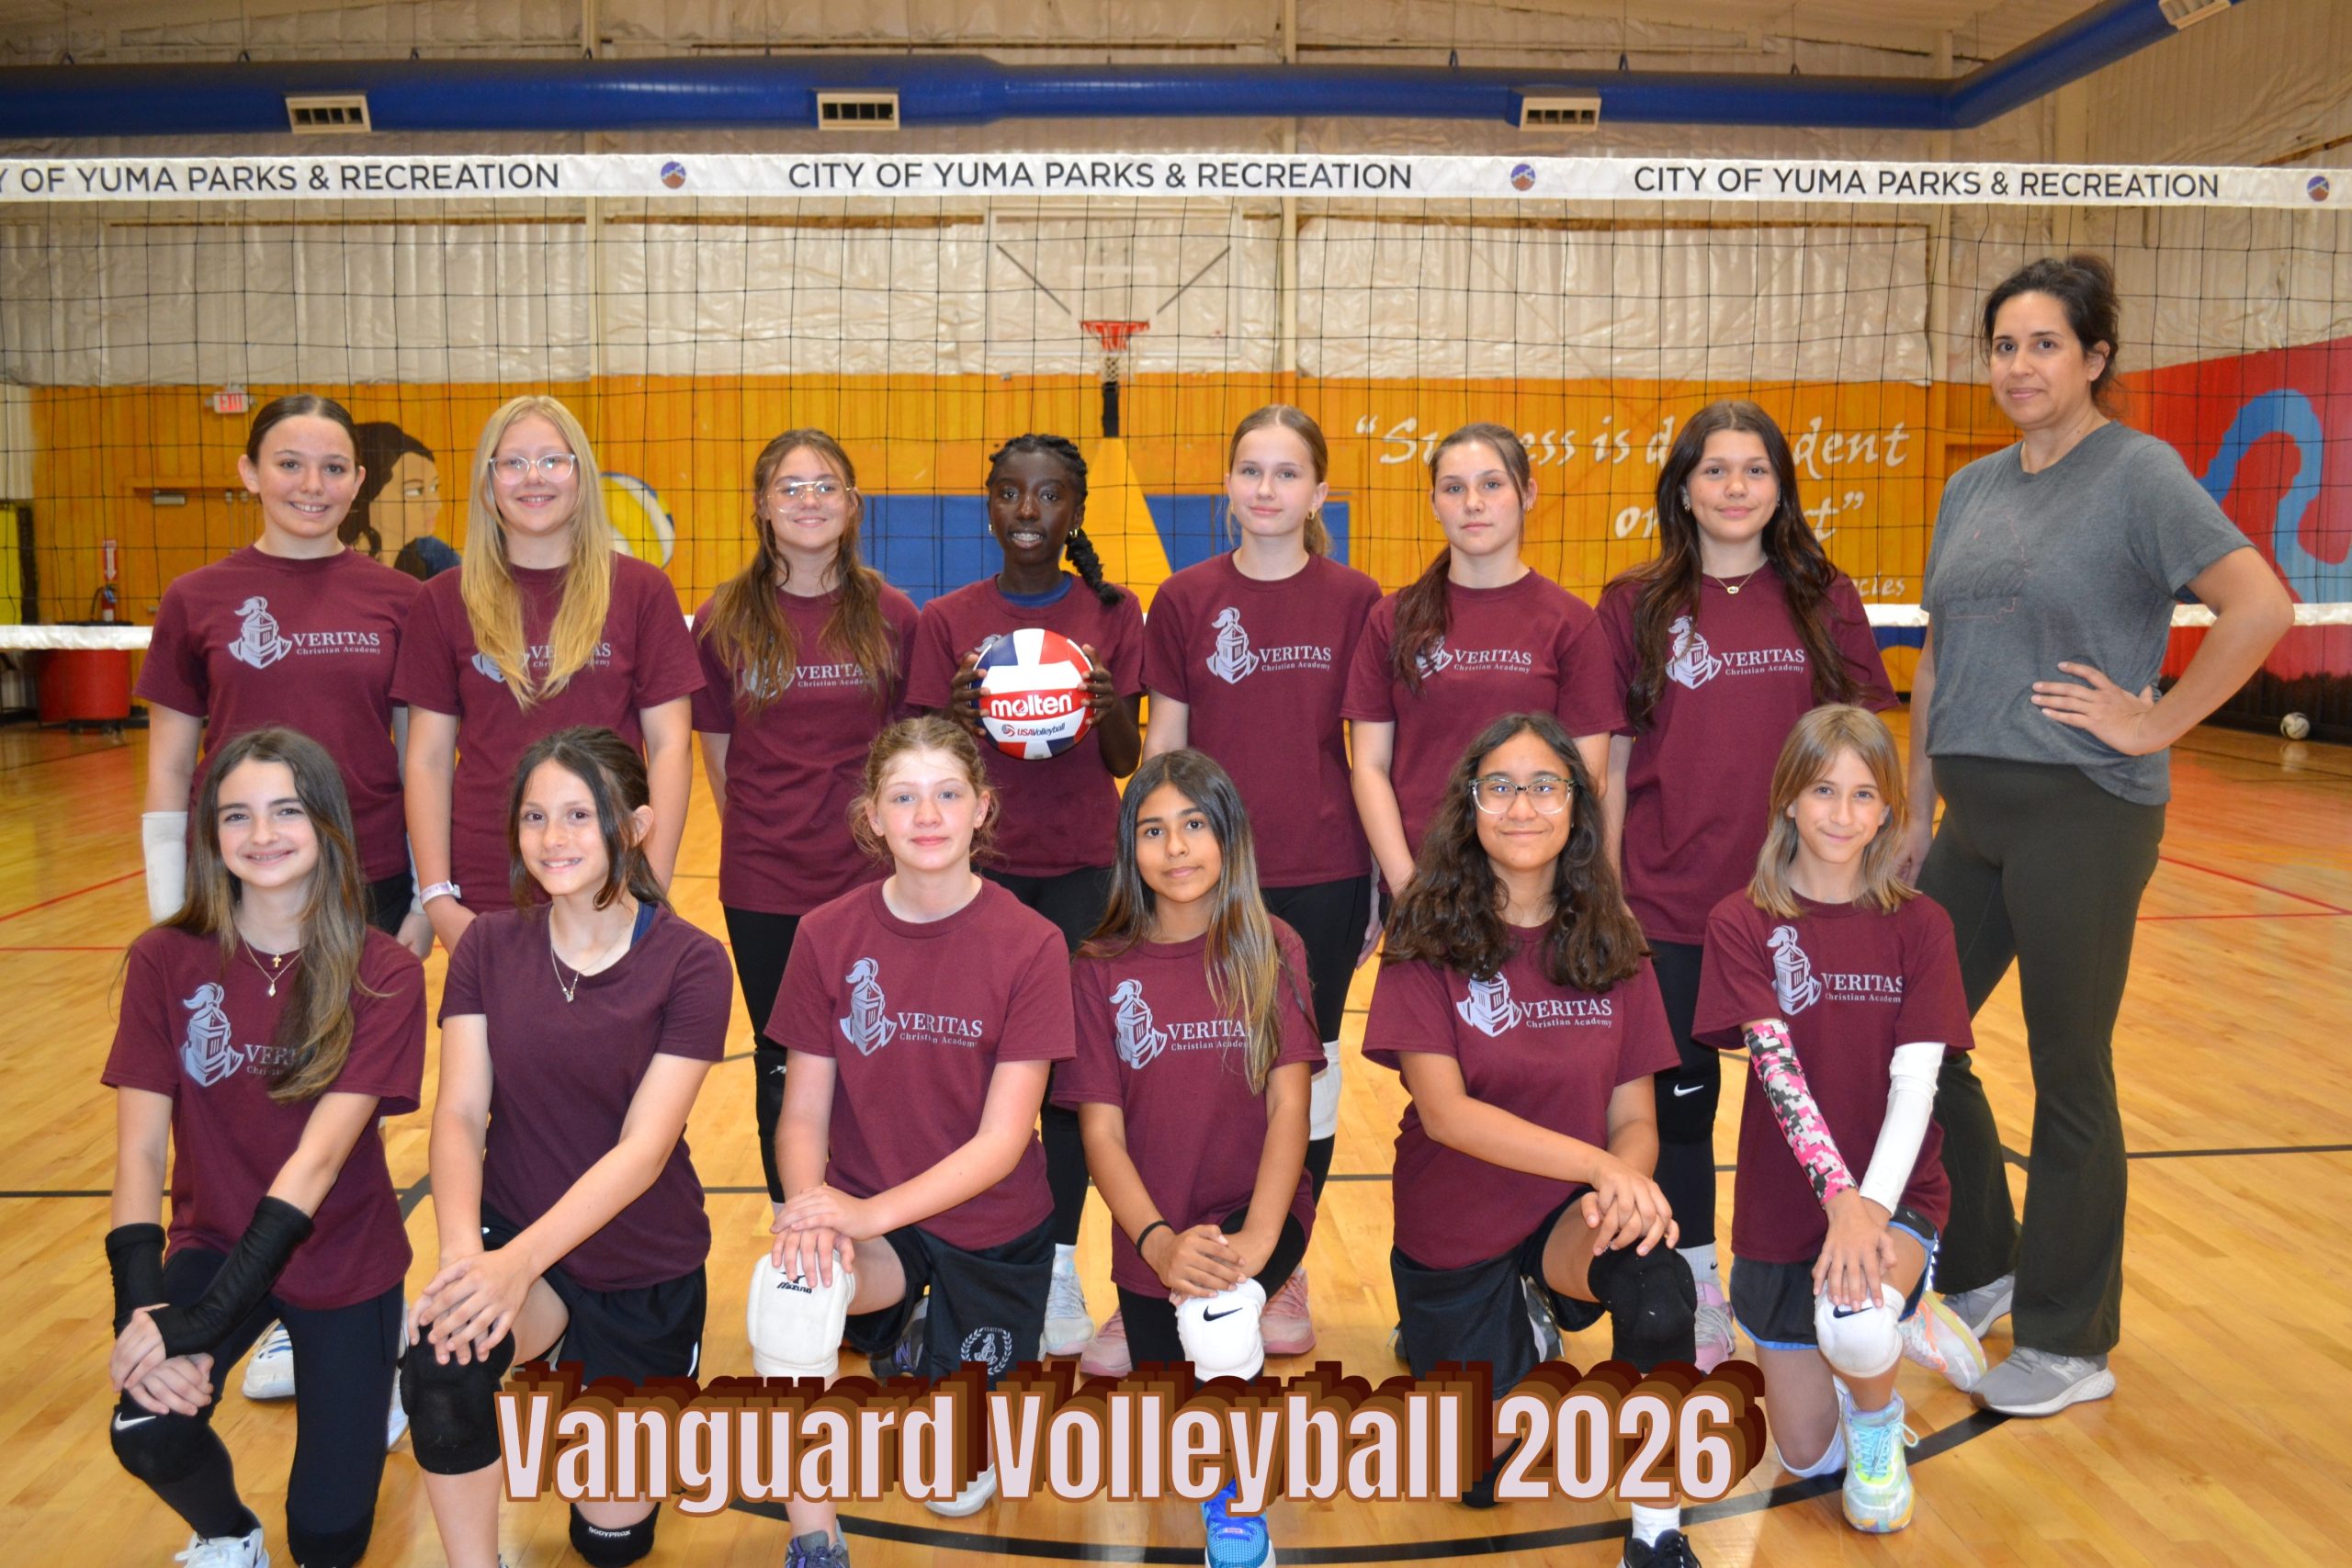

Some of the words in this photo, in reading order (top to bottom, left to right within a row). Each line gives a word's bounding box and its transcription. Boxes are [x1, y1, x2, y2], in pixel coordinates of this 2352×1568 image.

[21, 167, 64, 193] OF
[76, 166, 177, 193] YUMA
[187, 164, 296, 191] PARKS
[309, 164, 330, 190] &
[340, 163, 559, 190] RECREATION
[788, 162, 865, 188] CITY
[876, 162, 922, 188] OF
[933, 162, 1035, 187] YUMA
[1046, 162, 1154, 188] PARKS
[1165, 163, 1186, 188] &
[1198, 162, 1411, 189] RECREATION
[1634, 166, 1706, 192] CITY
[1718, 167, 1762, 193] OF
[1773, 168, 1866, 194] YUMA
[1878, 170, 1981, 195] PARKS
[1991, 171, 2008, 196] &
[2020, 172, 2218, 197] RECREATION
[220, 394, 243, 412] EXIT
[1591, 415, 1631, 464] is
[1645, 415, 1911, 479] ddent
[292, 631, 380, 647] VERITAS
[297, 647, 340, 655] Christian
[344, 646, 381, 655] Academy
[530, 642, 612, 660] VEAS
[1259, 646, 1331, 663] VERITAS
[1453, 649, 1532, 665] VERITAS
[1721, 649, 1805, 667] VERITAS
[796, 663, 868, 680] VERITA
[1261, 661, 1295, 671] Christian
[1298, 660, 1330, 671] Academy
[1494, 663, 1531, 674] Academy
[1725, 666, 1765, 676] Christian
[1768, 664, 1804, 674] Academy
[990, 694, 1073, 717] molten
[1825, 992, 1866, 1001] Christian
[1869, 993, 1901, 1003] Academ
[1521, 998, 1612, 1019] VERITAS
[897, 1011, 983, 1038] VERITAS
[1166, 1020, 1246, 1040] VERITA
[1526, 1018, 1570, 1029] Christian
[1574, 1017, 1612, 1028] Academy
[1171, 1041, 1214, 1051] Christian
